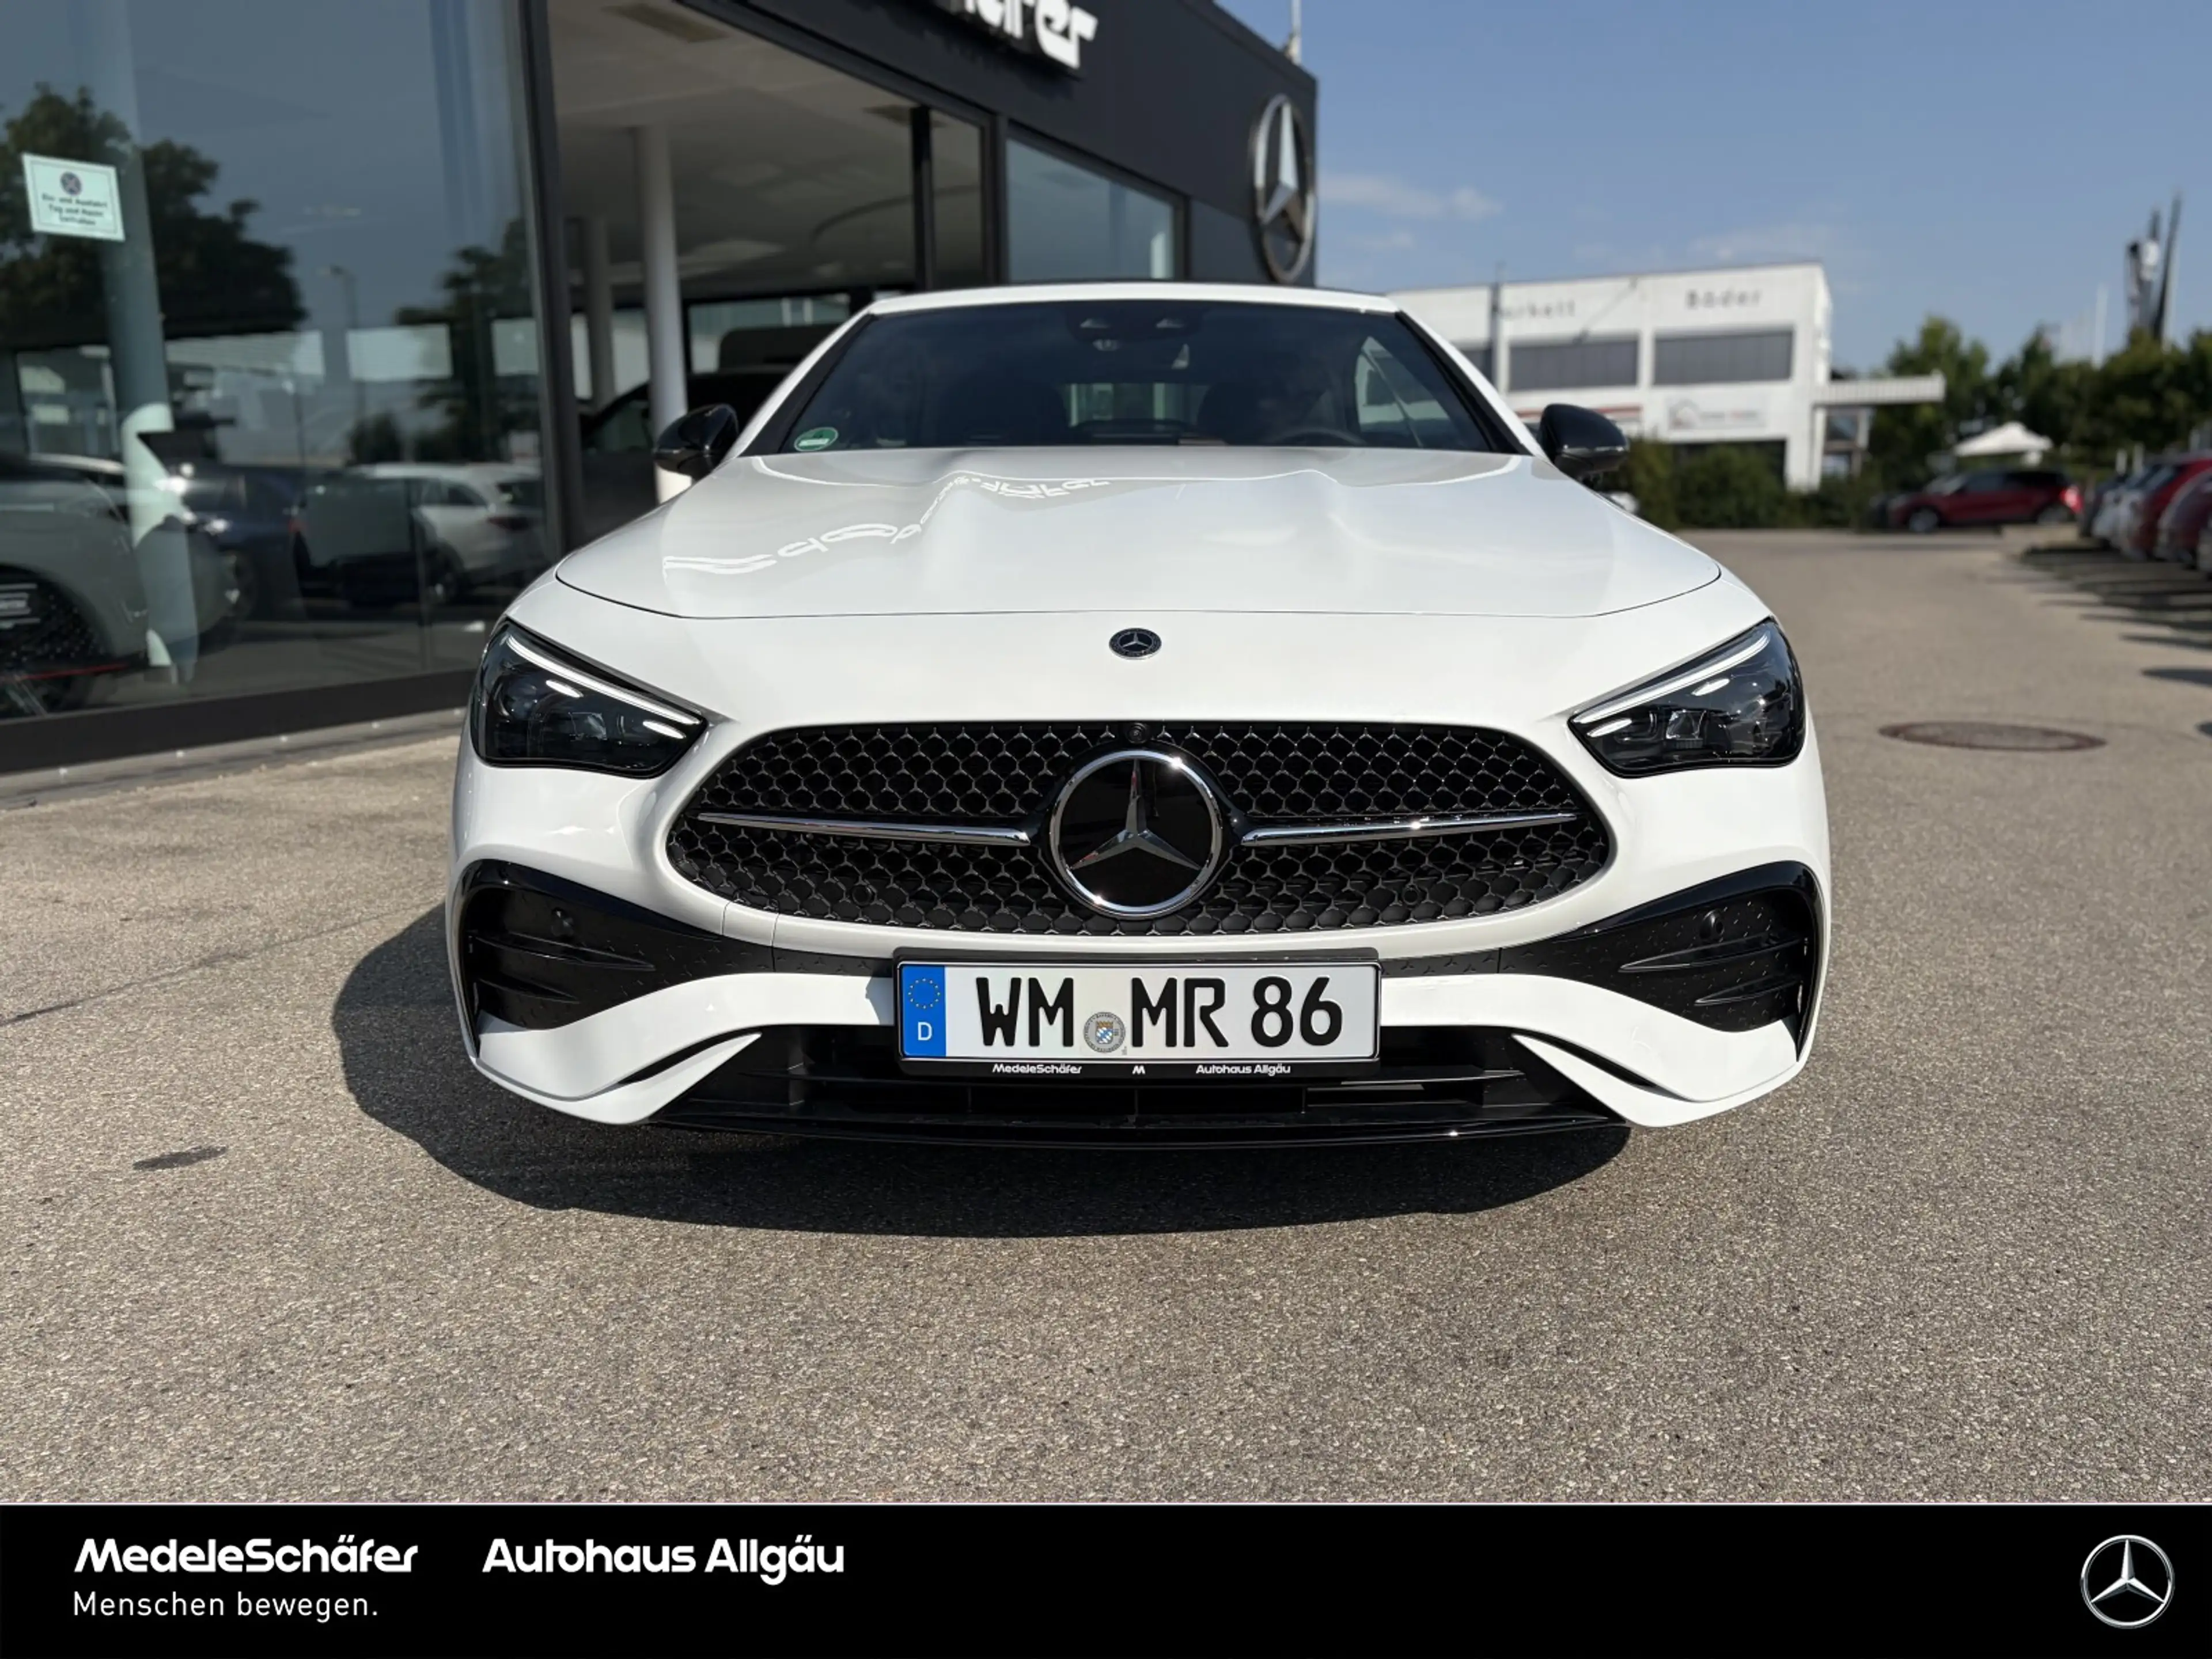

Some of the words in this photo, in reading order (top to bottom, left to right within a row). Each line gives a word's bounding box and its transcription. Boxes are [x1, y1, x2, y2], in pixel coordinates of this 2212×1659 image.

[976, 978, 1074, 1047] WM
[1132, 978, 1229, 1047] MR
[1251, 976, 1342, 1047] 86
[917, 1021, 933, 1041] D
[992, 1063, 1082, 1074] MedeleSchäfer
[1195, 1065, 1252, 1074] Autohaus
[1253, 1063, 1291, 1077] Allgäu
